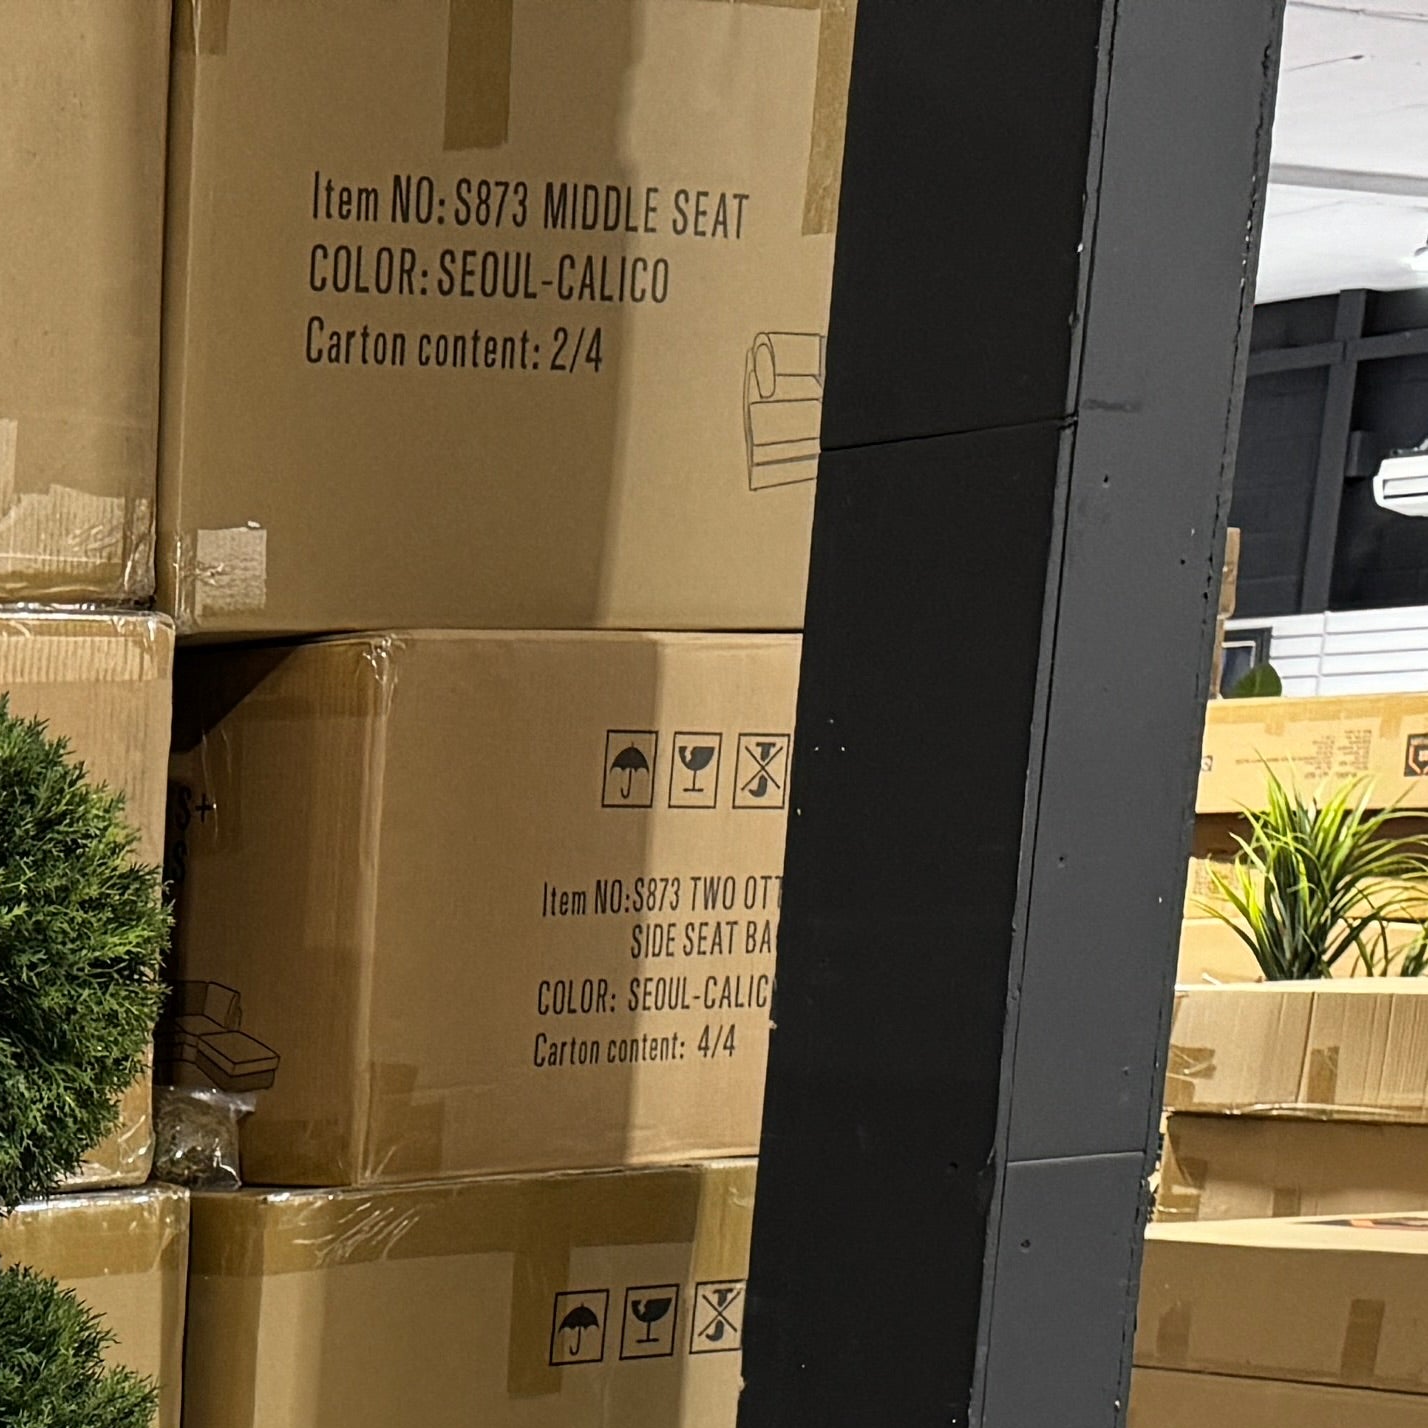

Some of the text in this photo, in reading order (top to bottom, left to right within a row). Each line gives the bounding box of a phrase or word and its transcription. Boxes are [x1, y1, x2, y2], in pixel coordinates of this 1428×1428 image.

[311, 170, 378, 223] Item
[543, 181, 660, 235] MIDDLE
[671, 188, 750, 239] SEAT
[305, 316, 603, 373] Carton content: 2/4
[542, 881, 586, 917] Item
[690, 876, 736, 912] TWO
[630, 923, 676, 960] SIDE
[683, 920, 738, 958] SEAT
[537, 974, 776, 1016] COLOR: SEOUL-CALIC
[534, 1024, 737, 1068] Carton content: 4/4
